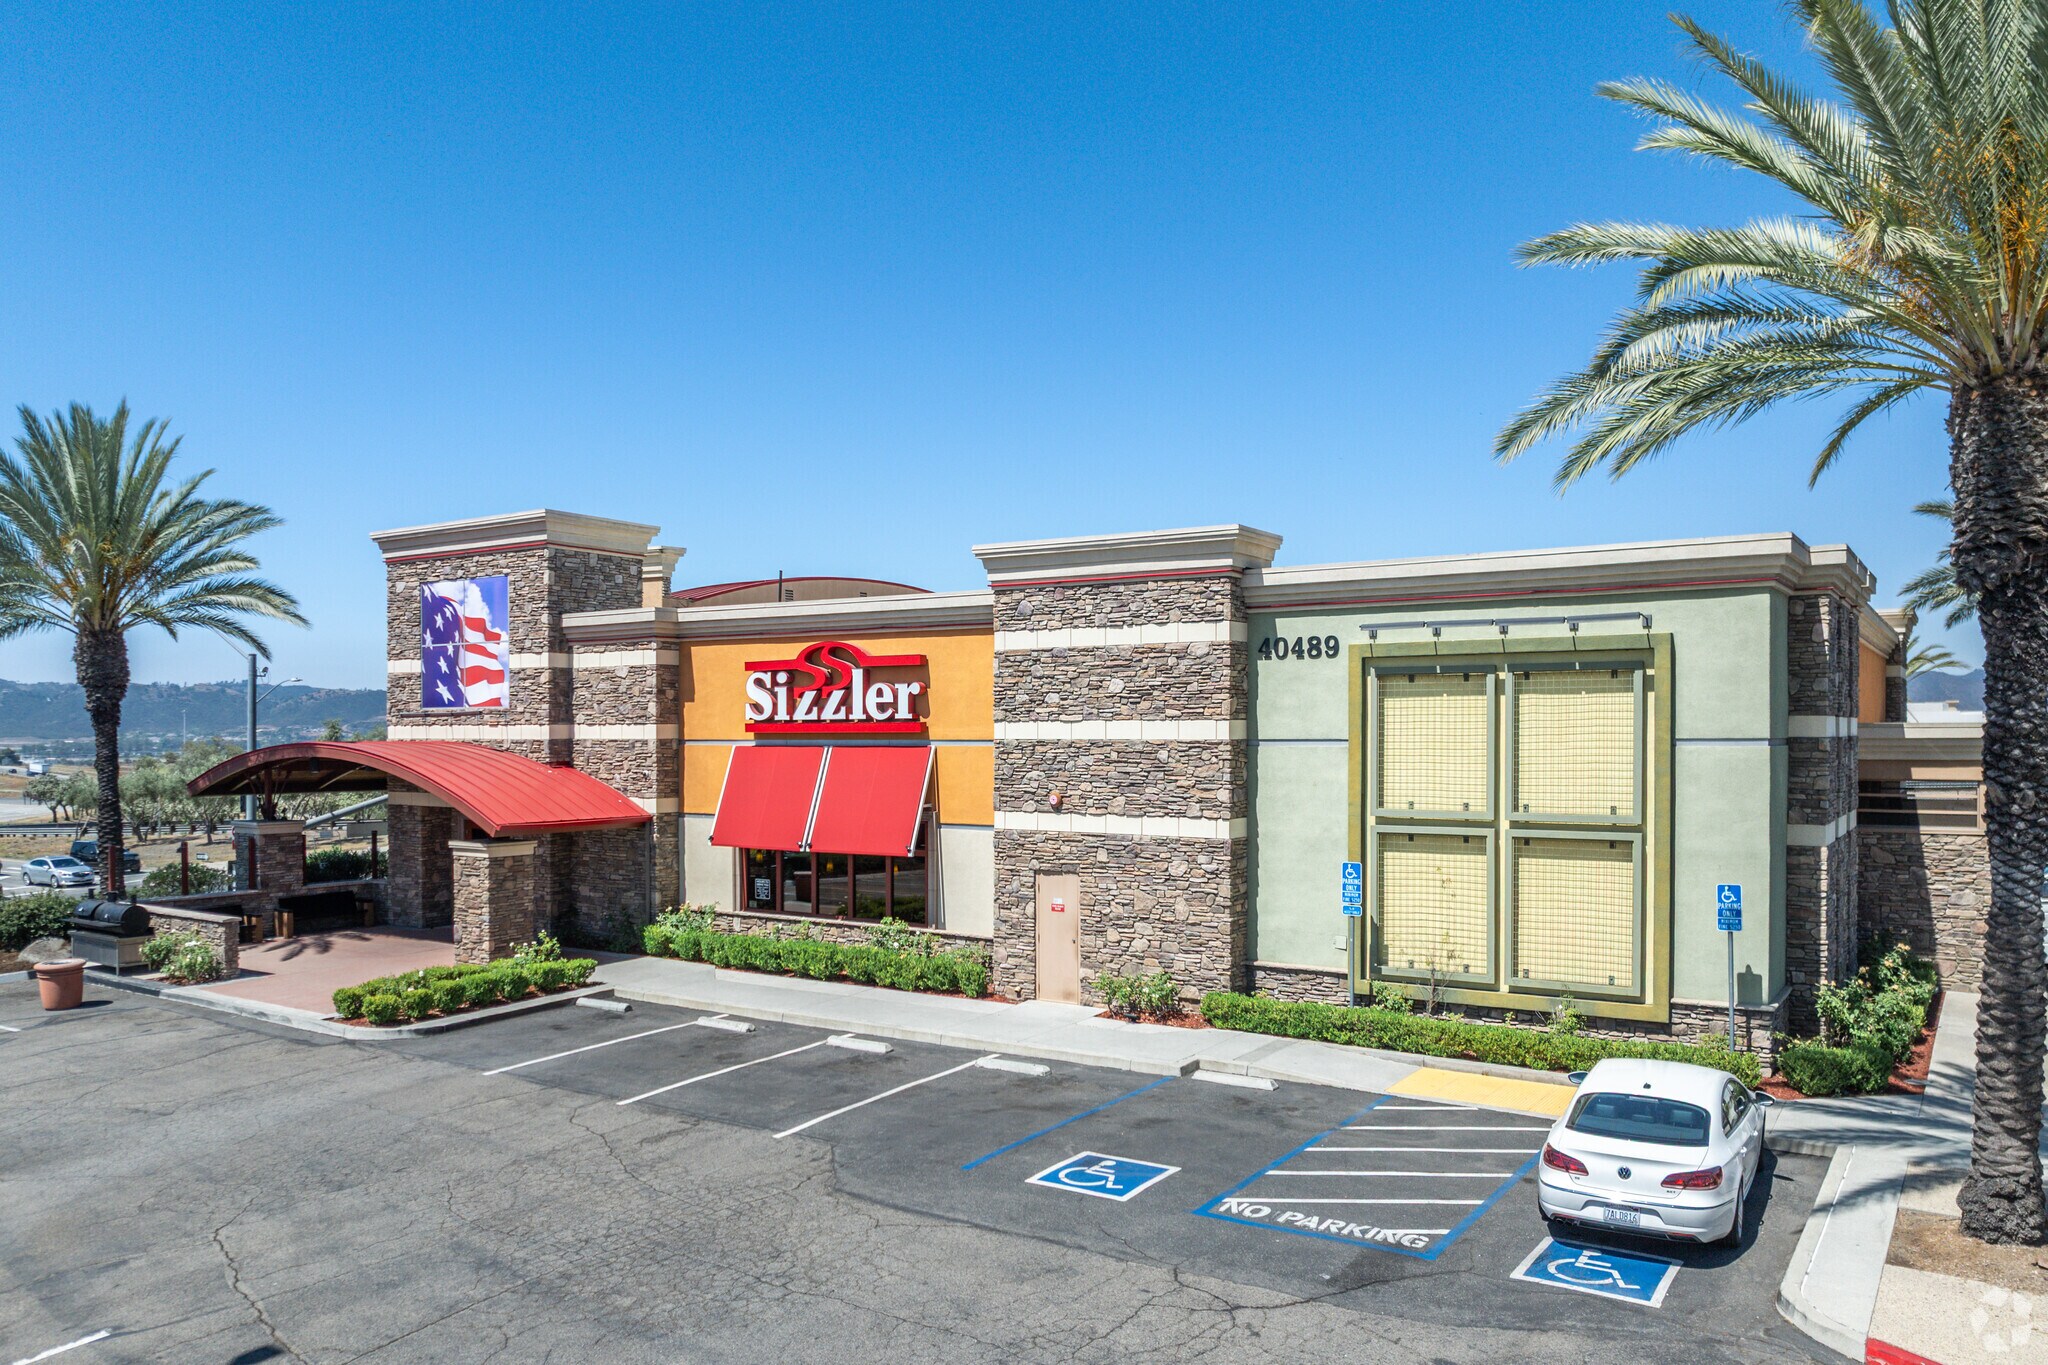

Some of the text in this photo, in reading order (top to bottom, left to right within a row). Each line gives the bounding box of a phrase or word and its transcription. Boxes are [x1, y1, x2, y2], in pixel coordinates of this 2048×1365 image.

[1258, 635, 1340, 660] 40489
[745, 667, 926, 721] Sizzler
[1718, 902, 1741, 910] PARKING
[1219, 1198, 1429, 1248] NO PARKING
[1606, 1209, 1637, 1222] 7ALD816
